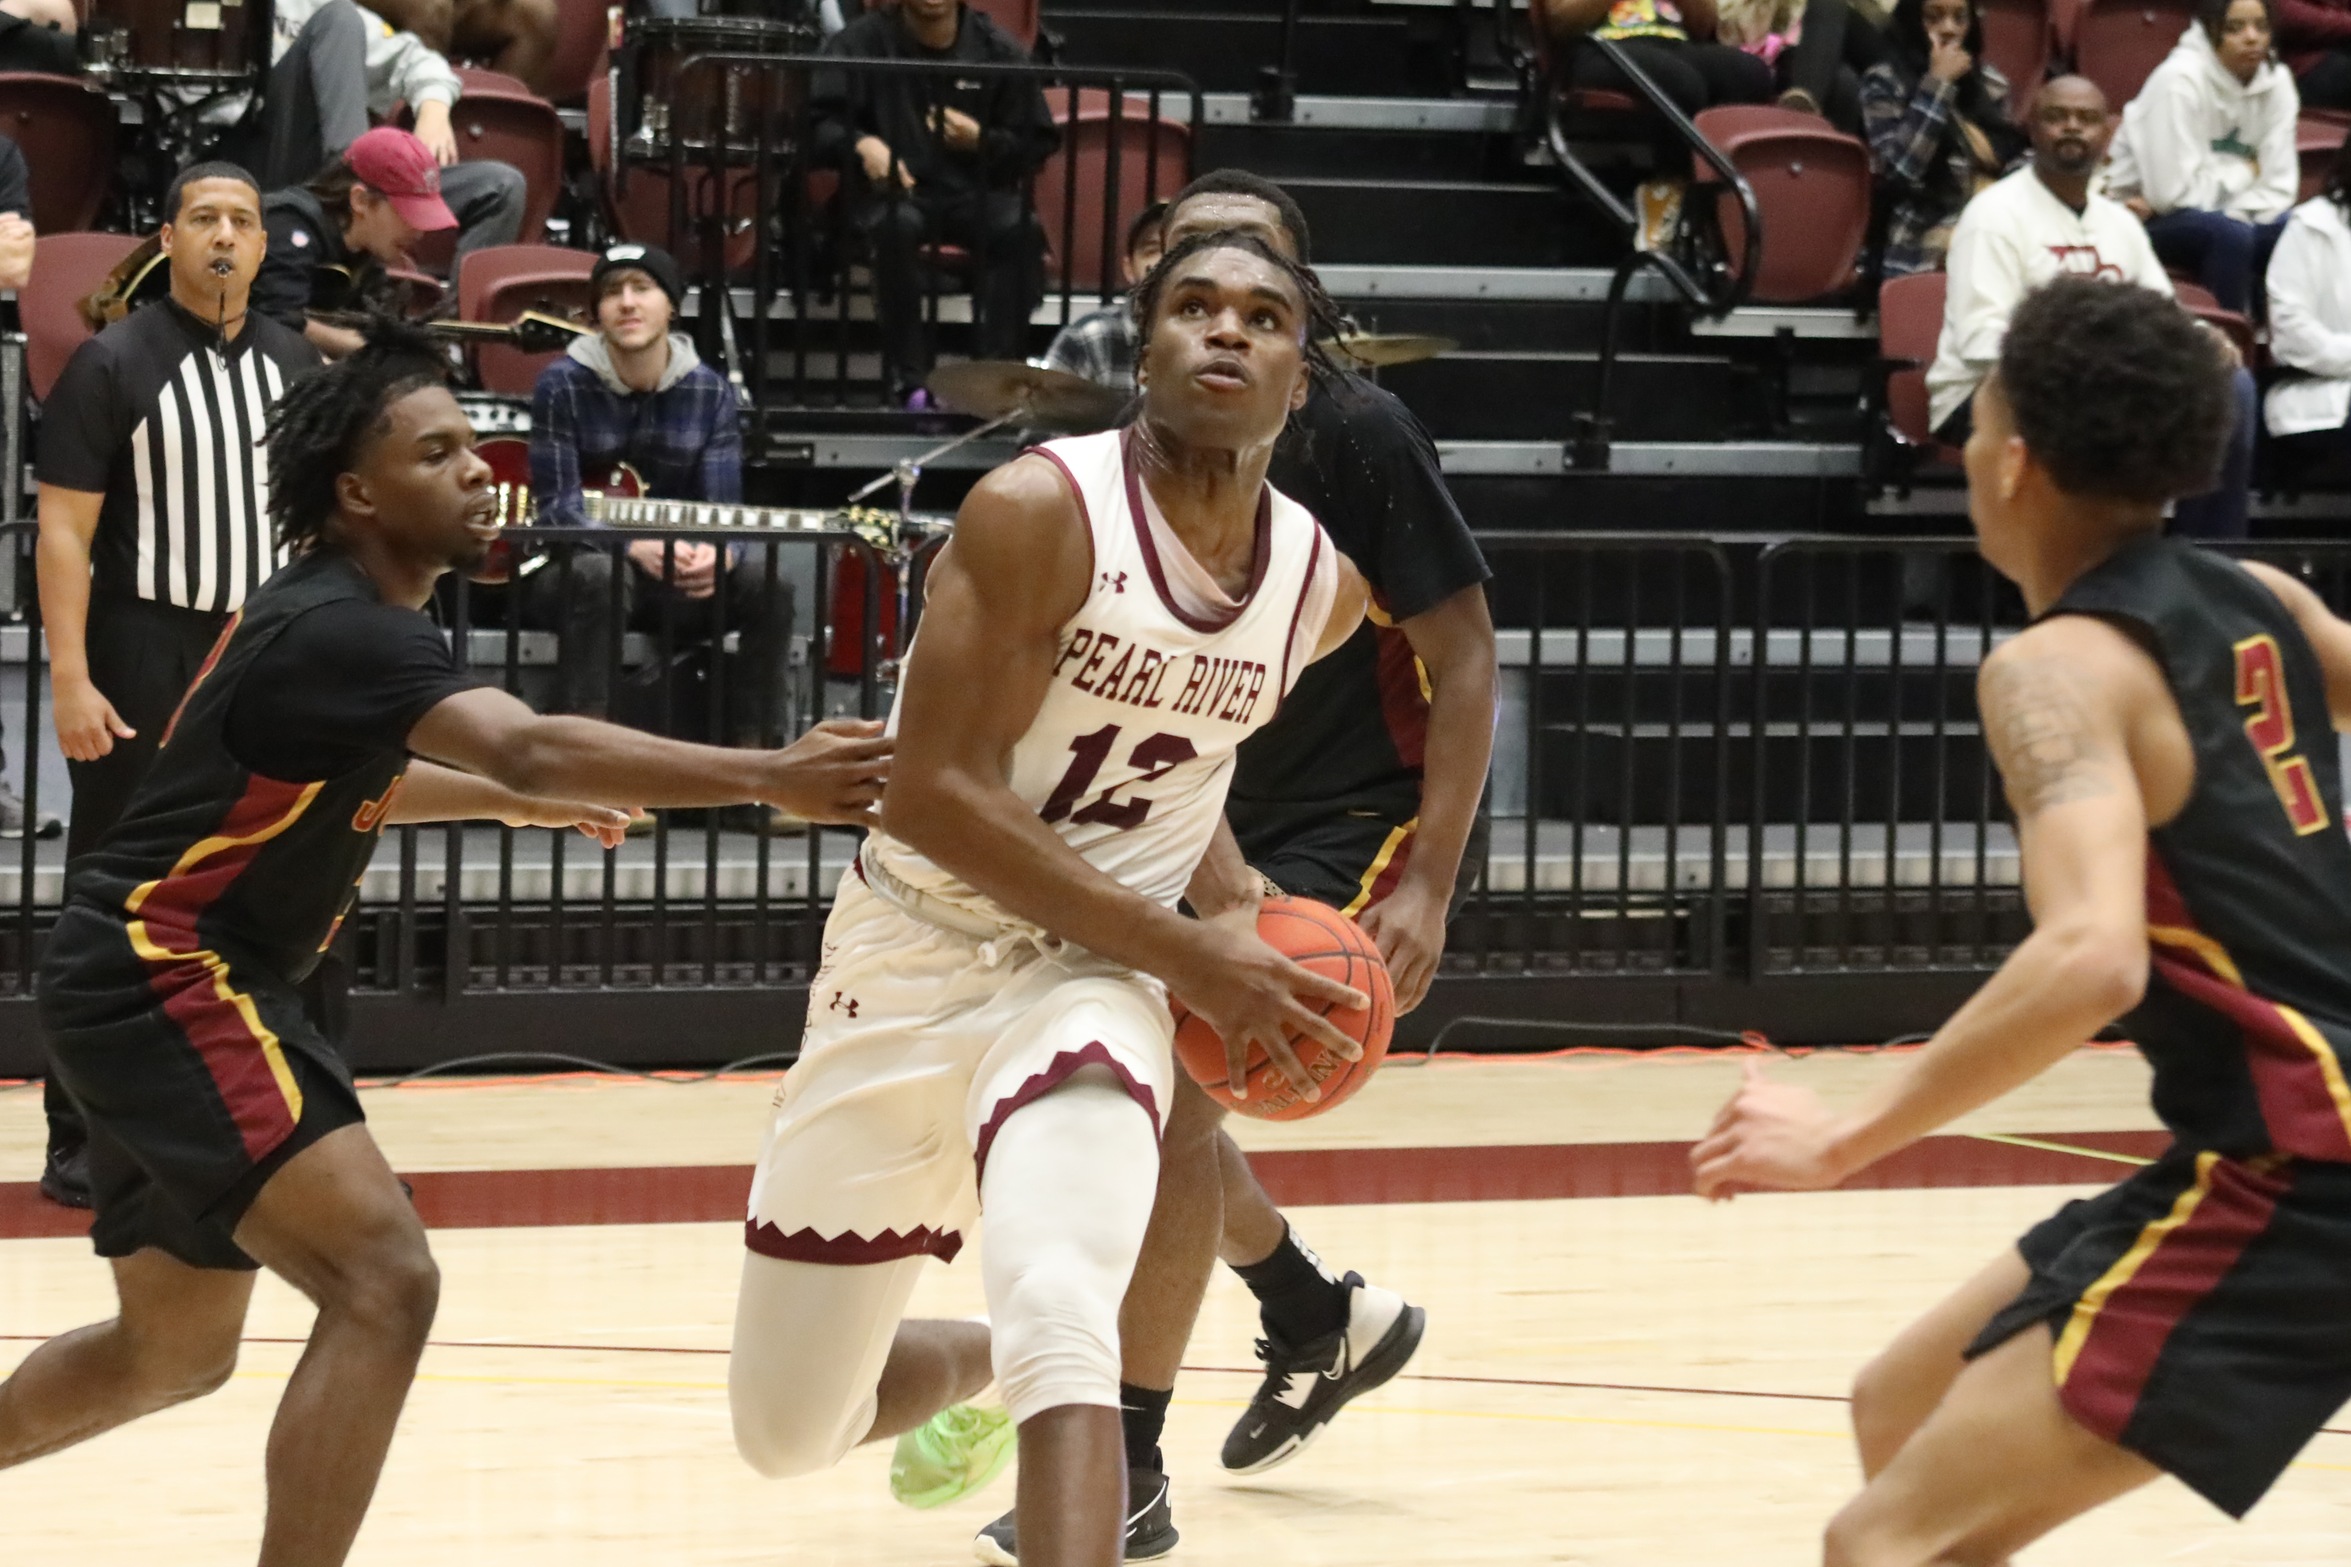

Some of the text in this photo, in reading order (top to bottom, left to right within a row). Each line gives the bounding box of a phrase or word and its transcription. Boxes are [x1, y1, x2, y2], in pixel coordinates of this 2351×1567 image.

[1052, 628, 1266, 725] PEARL RIVER
[1038, 722, 1199, 831] 12
[2232, 632, 2331, 836] 2
